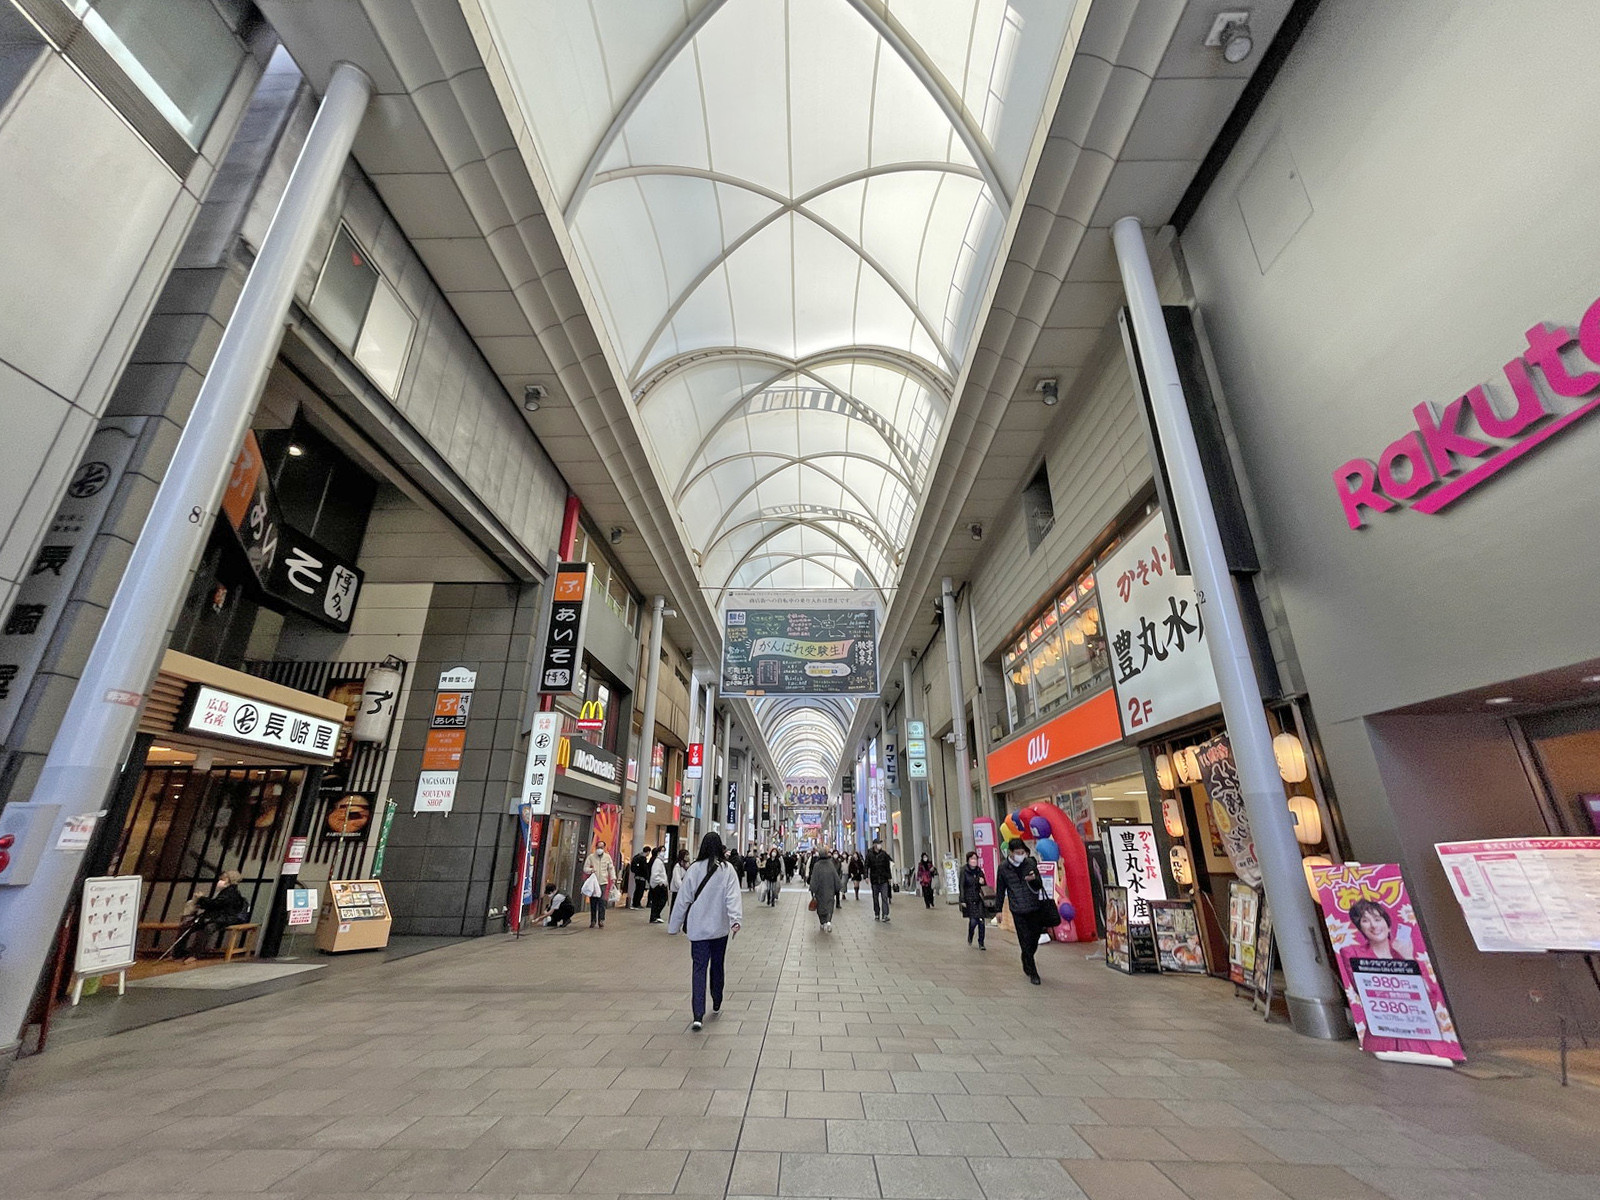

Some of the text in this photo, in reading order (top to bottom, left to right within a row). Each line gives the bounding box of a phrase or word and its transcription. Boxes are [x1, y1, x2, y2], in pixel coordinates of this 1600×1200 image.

[550, 607, 576, 664] あいそ
[1112, 596, 1205, 685] 豊丸水
[203, 711, 227, 727] 名産
[206, 698, 229, 714] 広島
[1128, 696, 1153, 729] 2F
[262, 712, 333, 751] 長崎屋
[573, 749, 616, 781] McDonald's
[885, 744, 897, 784] クマヒラ
[1027, 732, 1050, 766] au
[422, 790, 452, 798] SOUVENIR
[528, 754, 547, 806] 長崎屋
[426, 798, 443, 807] SHOP
[1138, 830, 1158, 880] かき小屋
[1119, 831, 1150, 918] 豊丸水産
[1313, 866, 1375, 888] スーパー
[1336, 880, 1402, 911] おトク
